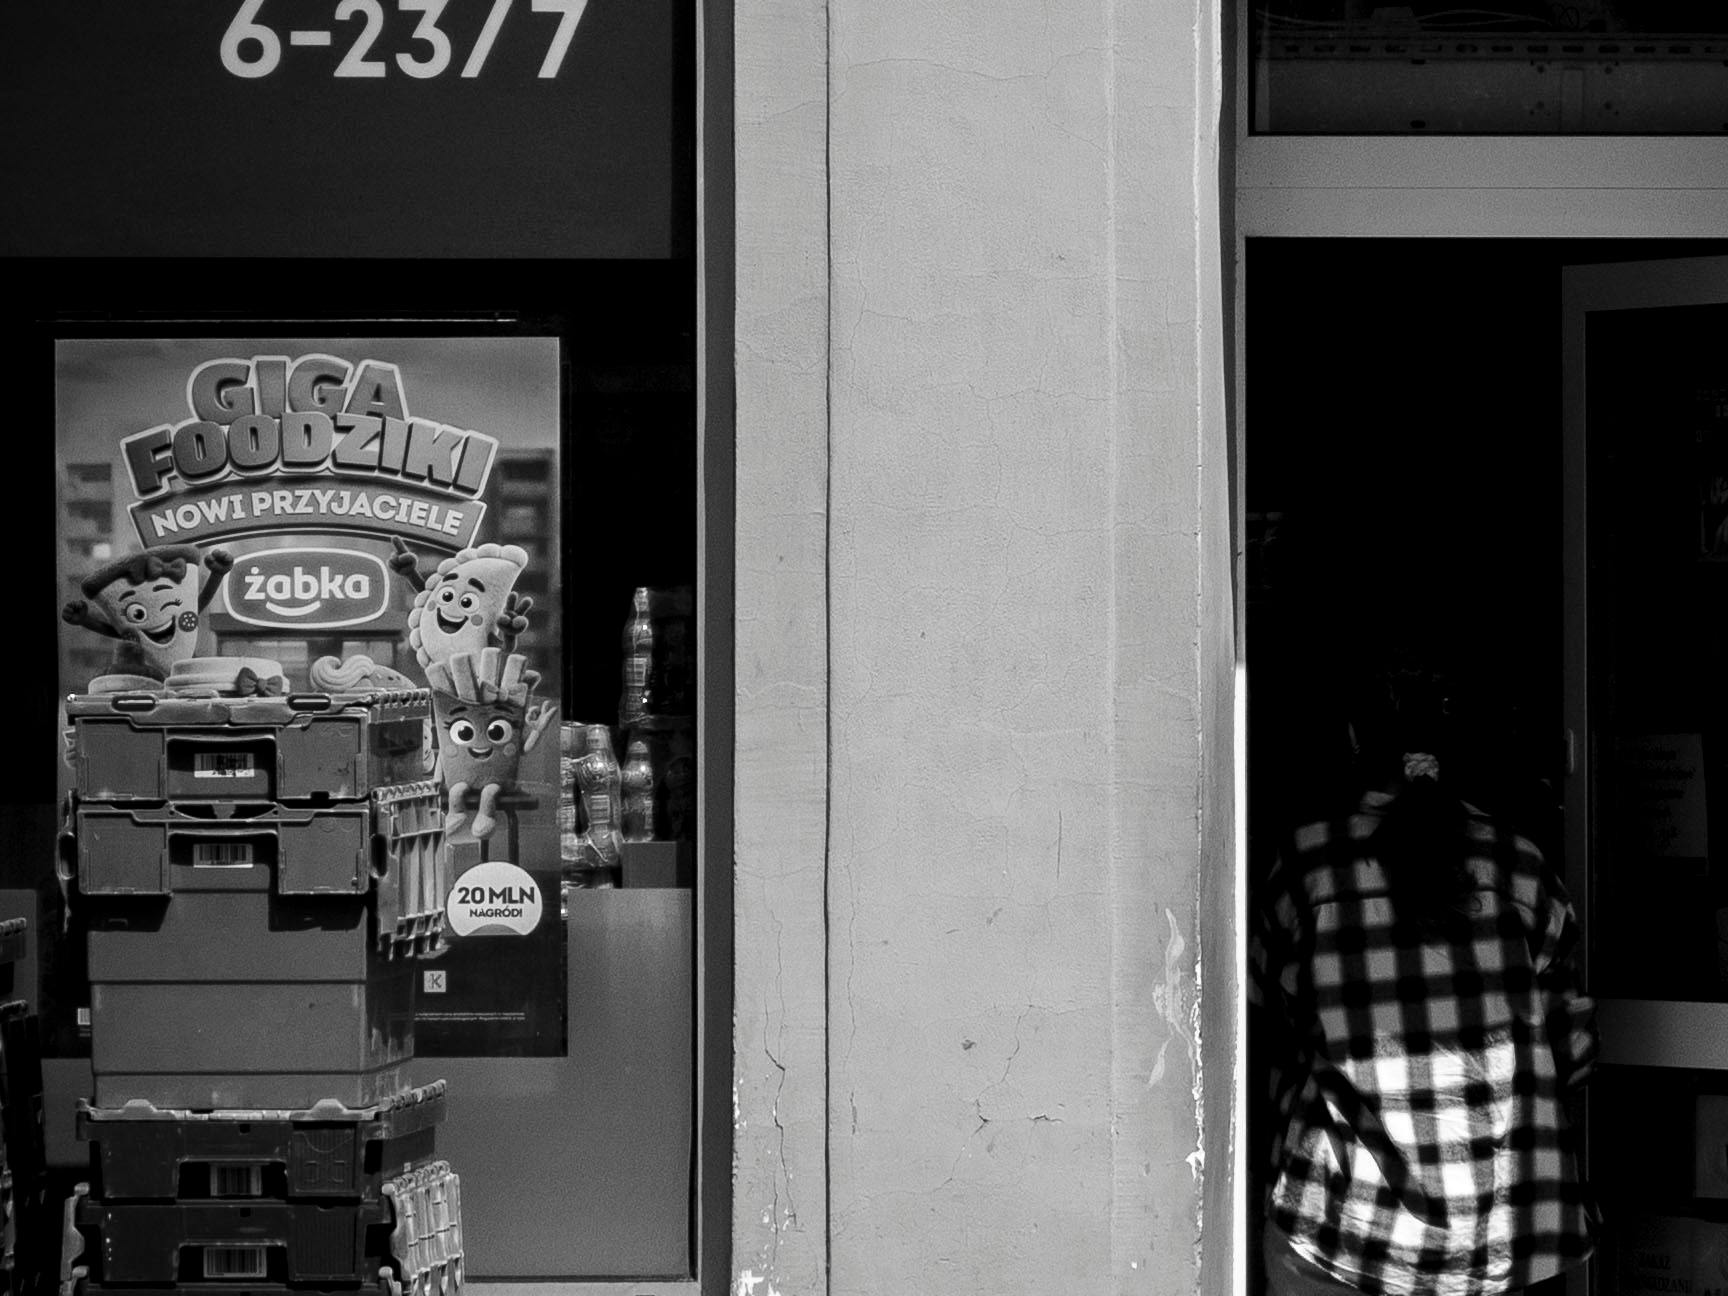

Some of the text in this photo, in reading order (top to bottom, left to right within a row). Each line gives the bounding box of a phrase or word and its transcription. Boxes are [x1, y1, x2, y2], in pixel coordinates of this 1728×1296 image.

[190, 356, 407, 421] GIGA
[124, 410, 496, 497] FOODZIKI
[151, 489, 464, 537] NOWI PRZYJACIELE
[243, 566, 370, 601] żabka
[457, 886, 535, 905] 20 MLN
